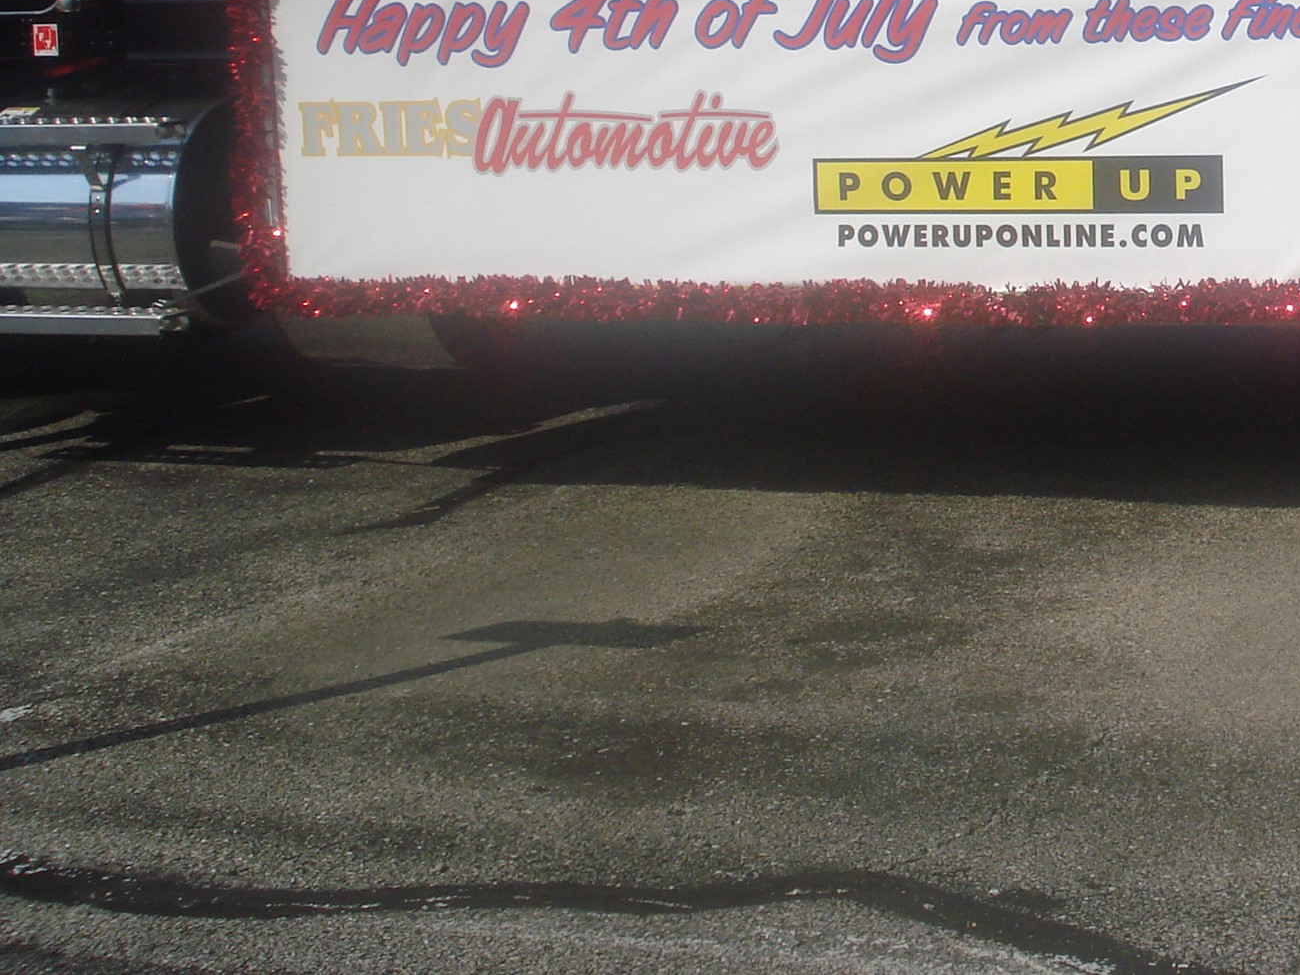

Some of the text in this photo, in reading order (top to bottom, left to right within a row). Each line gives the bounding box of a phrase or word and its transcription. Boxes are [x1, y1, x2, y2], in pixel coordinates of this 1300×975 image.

[956, 1, 1074, 46] from
[298, 90, 779, 176] FRIES Automotive
[838, 169, 1202, 201] POWER UP
[838, 224, 1204, 248] POWERUPONLINE.COM
